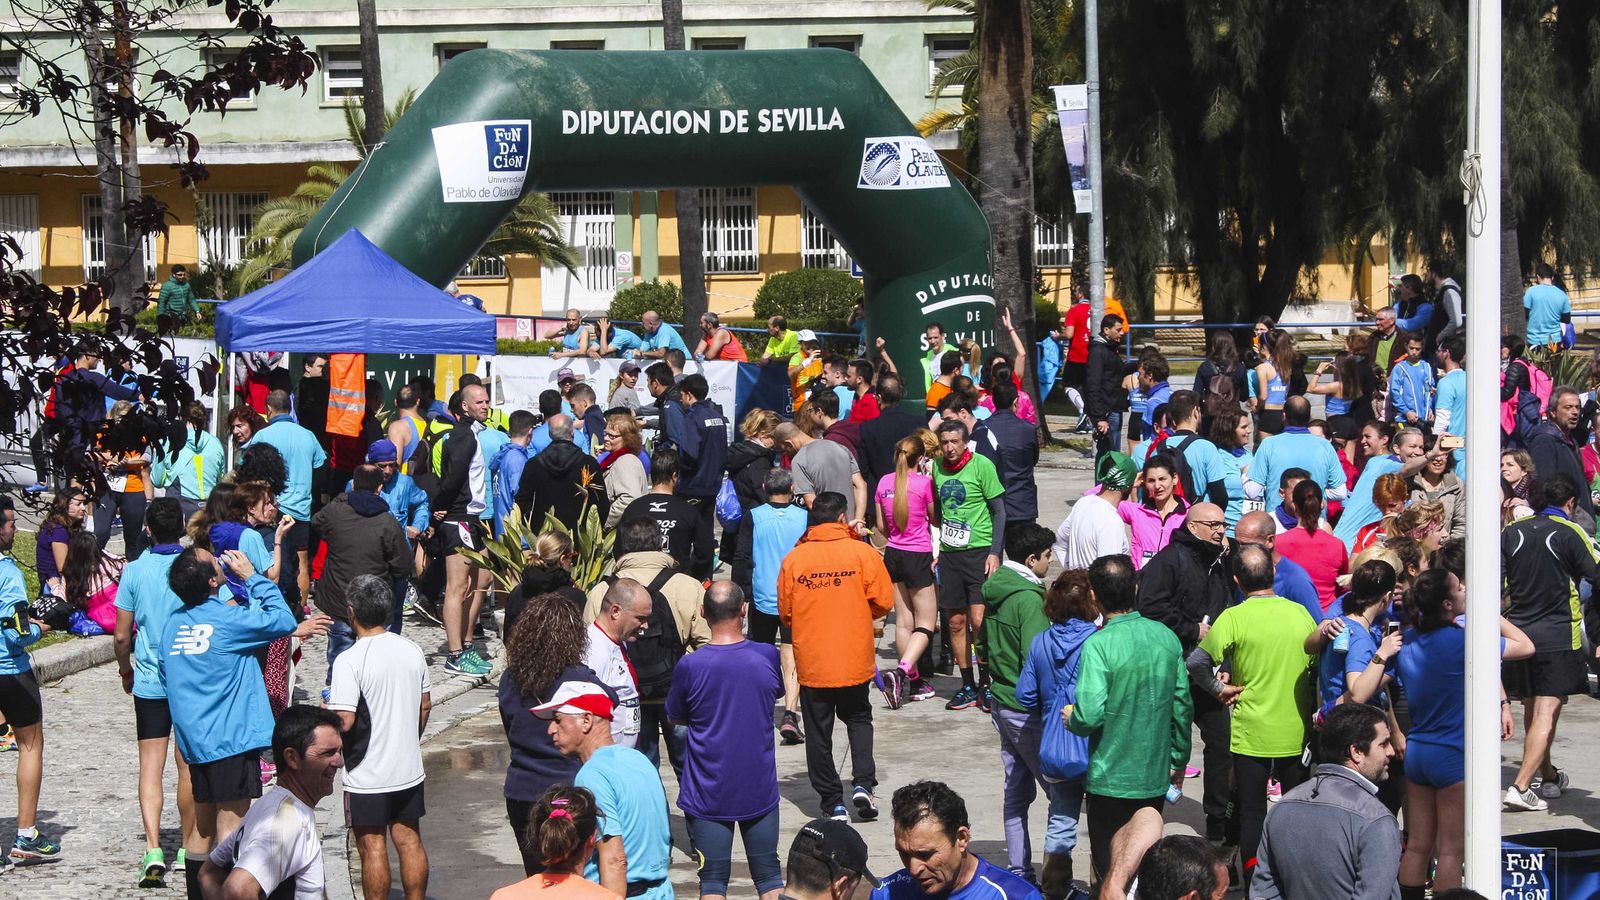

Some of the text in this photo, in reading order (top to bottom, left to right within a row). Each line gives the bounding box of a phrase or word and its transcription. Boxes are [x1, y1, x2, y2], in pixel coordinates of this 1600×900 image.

[562, 107, 845, 135] DIPUTACION DE SEVILLA
[499, 142, 518, 155] DA
[446, 187, 477, 199] Pablo
[478, 187, 491, 198] de
[966, 310, 981, 323] DE
[944, 526, 965, 540] 1073
[810, 570, 856, 580] DUNLOP
